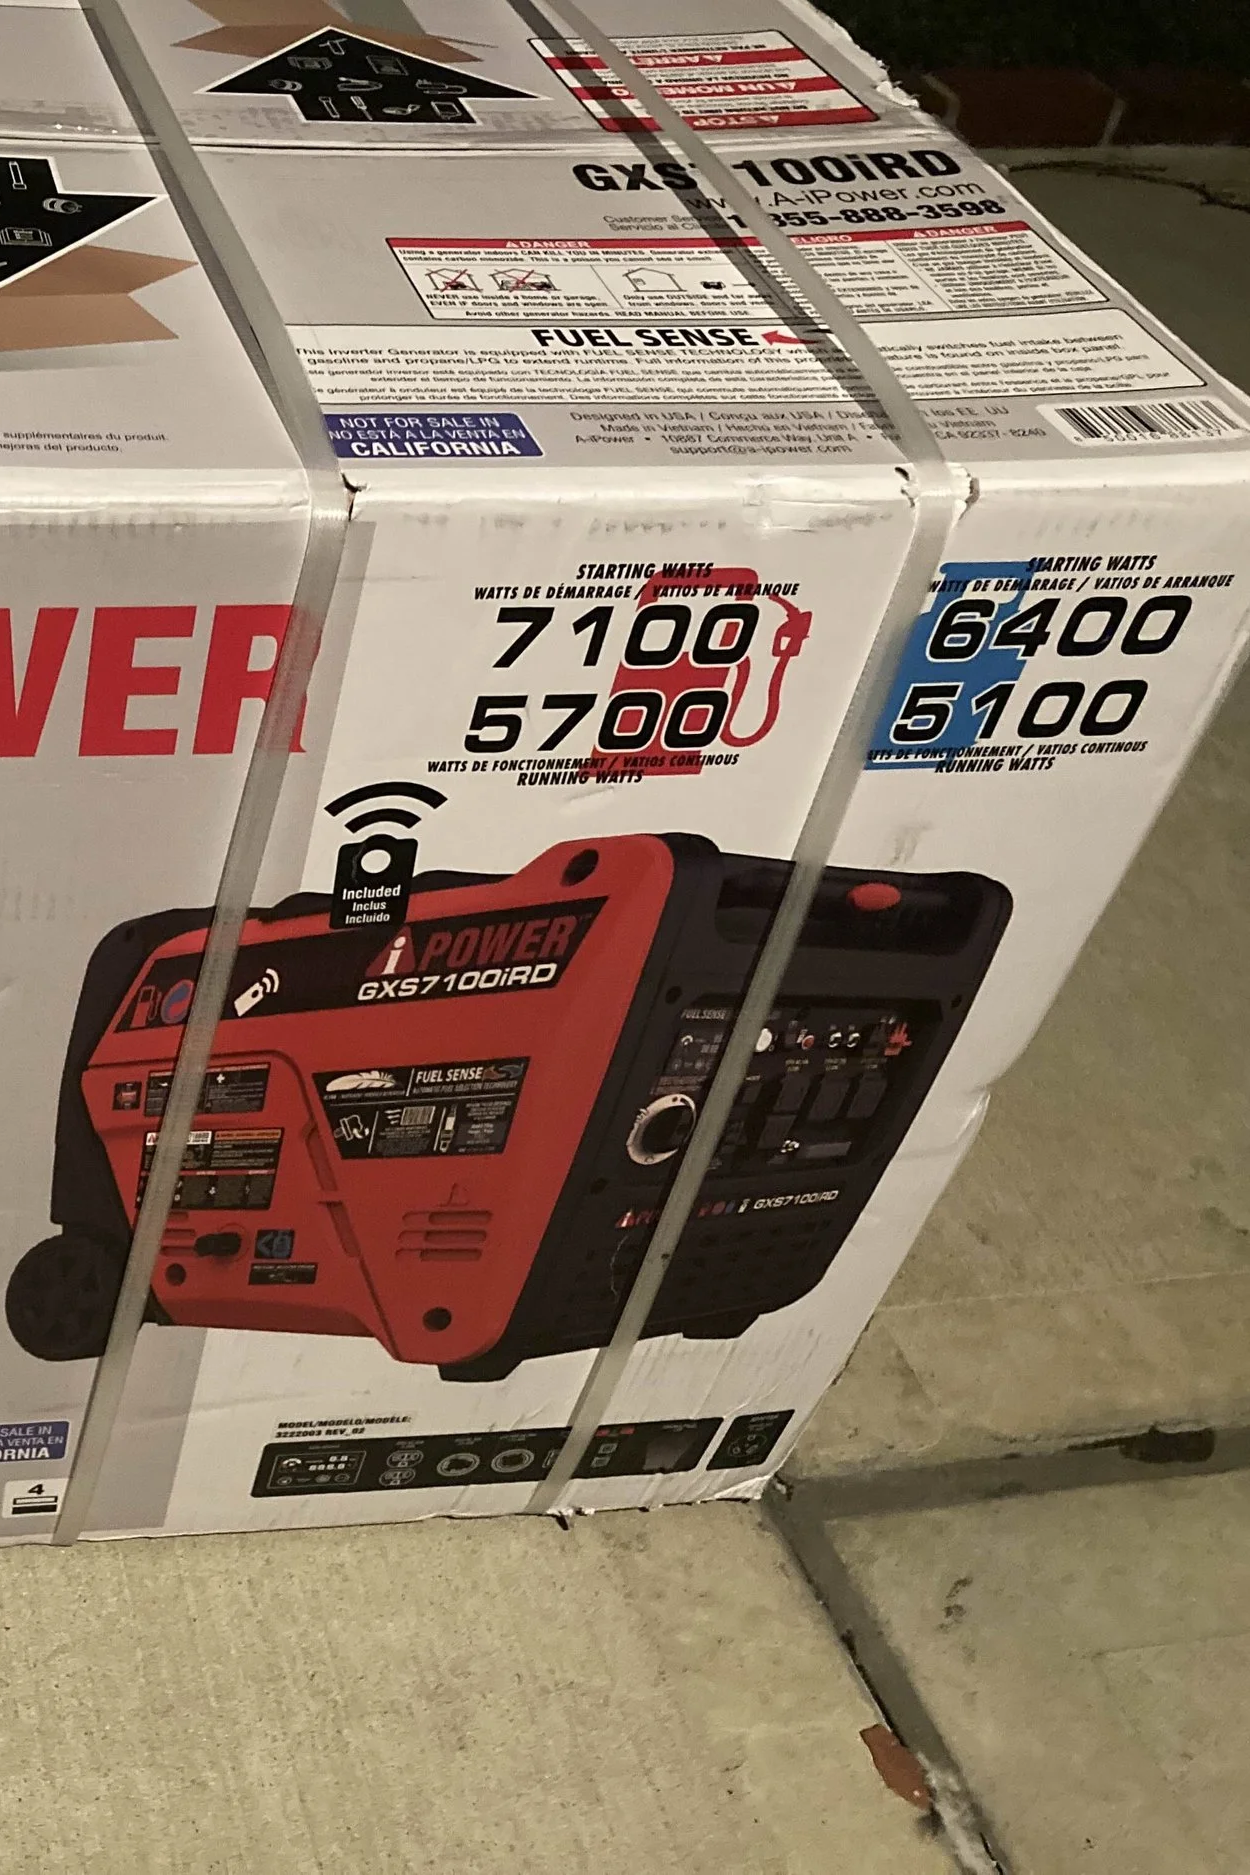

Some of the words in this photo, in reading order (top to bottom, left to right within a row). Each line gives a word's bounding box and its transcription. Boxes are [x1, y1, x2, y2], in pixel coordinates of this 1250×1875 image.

[572, 150, 961, 192] GXS100iRD
[519, 240, 591, 249] DANGER
[532, 328, 631, 347] FUEL
[639, 326, 754, 346] SENSE
[339, 417, 377, 428] NOT
[383, 417, 423, 428] FOR
[426, 417, 476, 428] SALE
[479, 417, 500, 428] IN
[328, 430, 352, 440] NO
[358, 427, 400, 440] ESTÁ
[405, 429, 417, 439] A
[422, 429, 443, 439] LA
[447, 429, 501, 439] VENTA
[504, 429, 526, 439] EN
[350, 441, 521, 457] CALIFORNIA
[576, 563, 655, 580] STARTING
[661, 562, 714, 579] WATTS
[1026, 556, 1102, 573] STARTING
[1106, 555, 1158, 571] WATTS
[474, 586, 519, 600] WATTS
[522, 585, 541, 599] DE
[545, 583, 632, 600] DÉMARRAGE
[634, 584, 648, 600] /
[652, 584, 699, 598] VATIOS
[703, 584, 720, 597] DE
[725, 583, 800, 598] ARRANQUE
[492, 604, 760, 668] 7100
[930, 595, 1193, 661] 6400
[891, 679, 1149, 743] 5100
[464, 689, 729, 753] 5700
[428, 760, 468, 772] WATTS
[471, 760, 488, 772] DE
[492, 757, 607, 772] FONCTIONNEMENT
[608, 756, 619, 770] /
[623, 756, 666, 768] VATIOS
[670, 754, 740, 767] CONTINOUS
[934, 759, 1005, 773] RUNNING
[1008, 757, 1056, 771] WATTS
[517, 771, 589, 786] RUNNING
[595, 769, 644, 784] WATTS
[342, 884, 402, 900] Included
[352, 901, 386, 911] Inclus
[345, 912, 390, 924] Incluido
[418, 915, 577, 971] POWER
[357, 963, 557, 1001] GXS7100iRD
[416, 1070, 443, 1083] FUEL
[447, 1067, 483, 1080] SENSE
[0, 1427, 34, 1438] SALE
[38, 1425, 52, 1435] IN
[7, 1437, 44, 1446] VENTA
[47, 1435, 64, 1445] EN
[28, 1483, 45, 1496] 4
